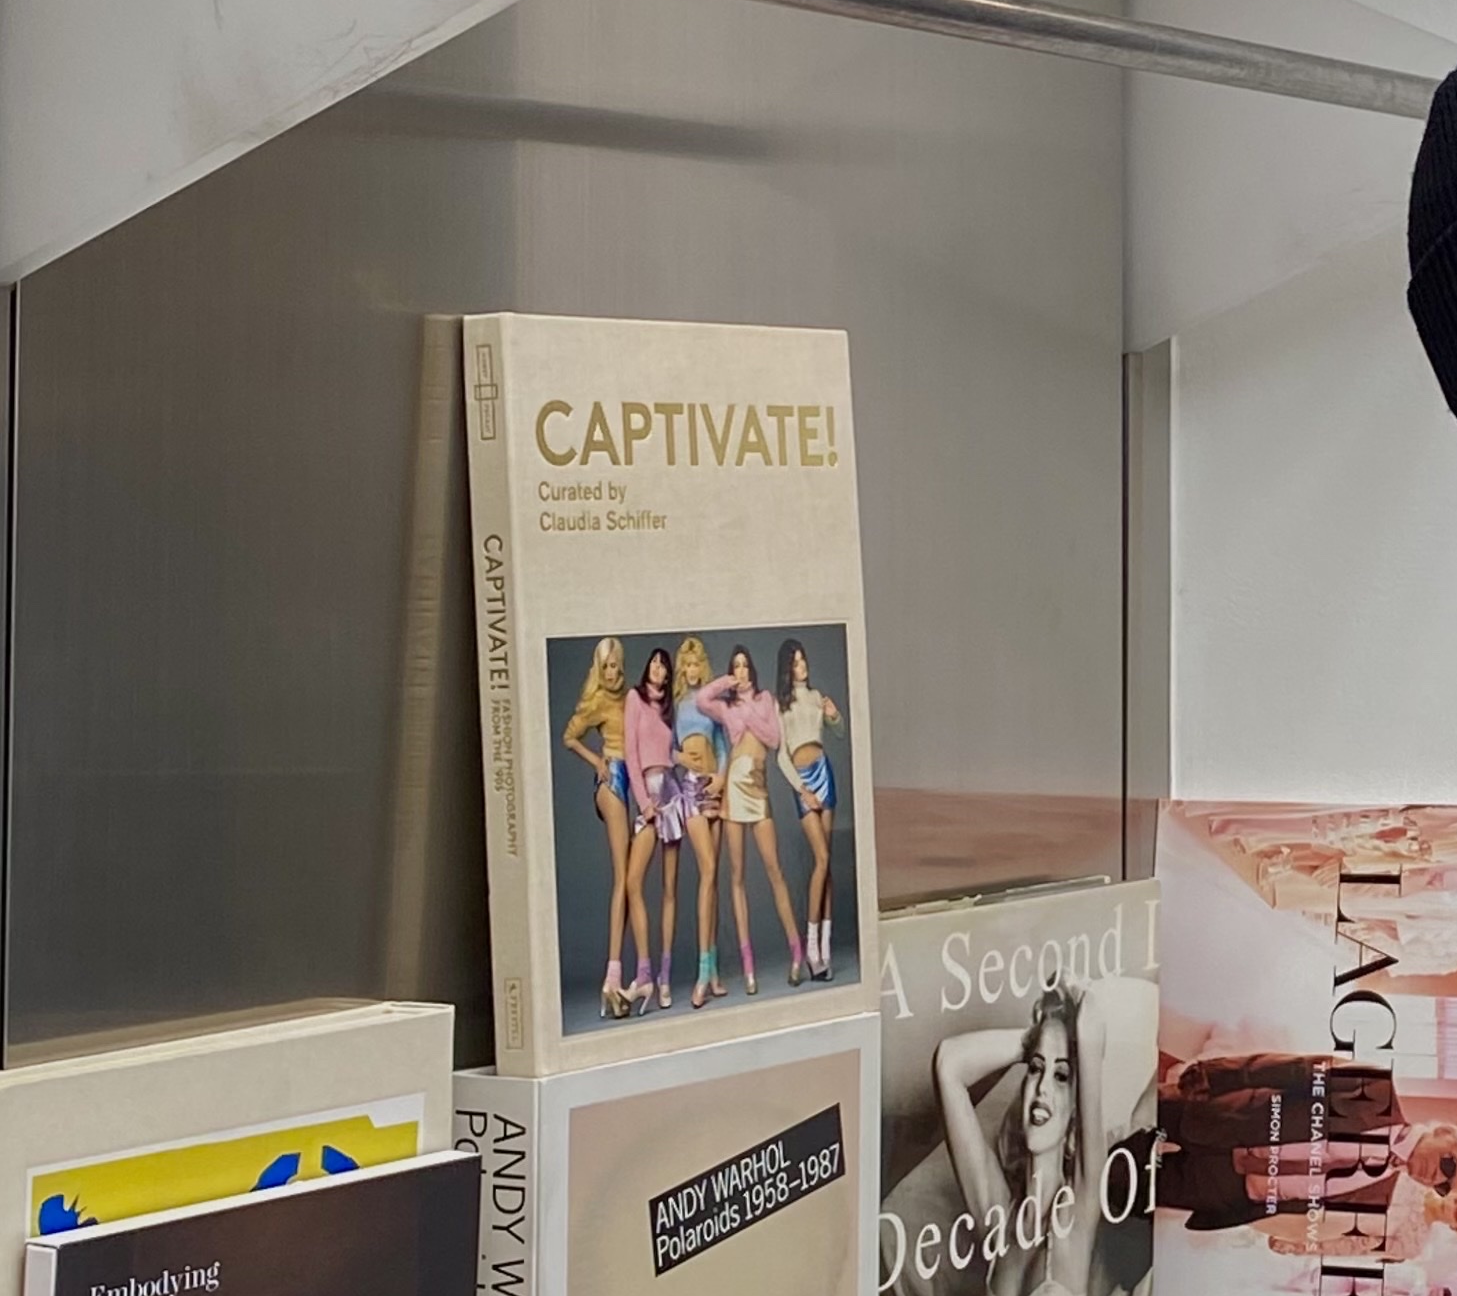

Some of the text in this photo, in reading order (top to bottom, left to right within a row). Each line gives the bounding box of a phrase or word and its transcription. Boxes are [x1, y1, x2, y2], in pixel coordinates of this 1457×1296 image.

[535, 399, 839, 468] CAPTIVATE!
[538, 480, 628, 505] Curated by
[539, 509, 668, 532] Claudia Schiffer
[483, 534, 511, 691] CAPTIVATE!
[940, 904, 1124, 1013] Second
[492, 1113, 527, 1244] ANDY
[655, 1139, 792, 1234] ANDY WARHOL
[1265, 1094, 1283, 1215] SIMON PROCTER
[1305, 1060, 1326, 1252] THE CHANEL SHOWS
[656, 1201, 741, 1268] Polaroids
[880, 1172, 1077, 1292] Decade
